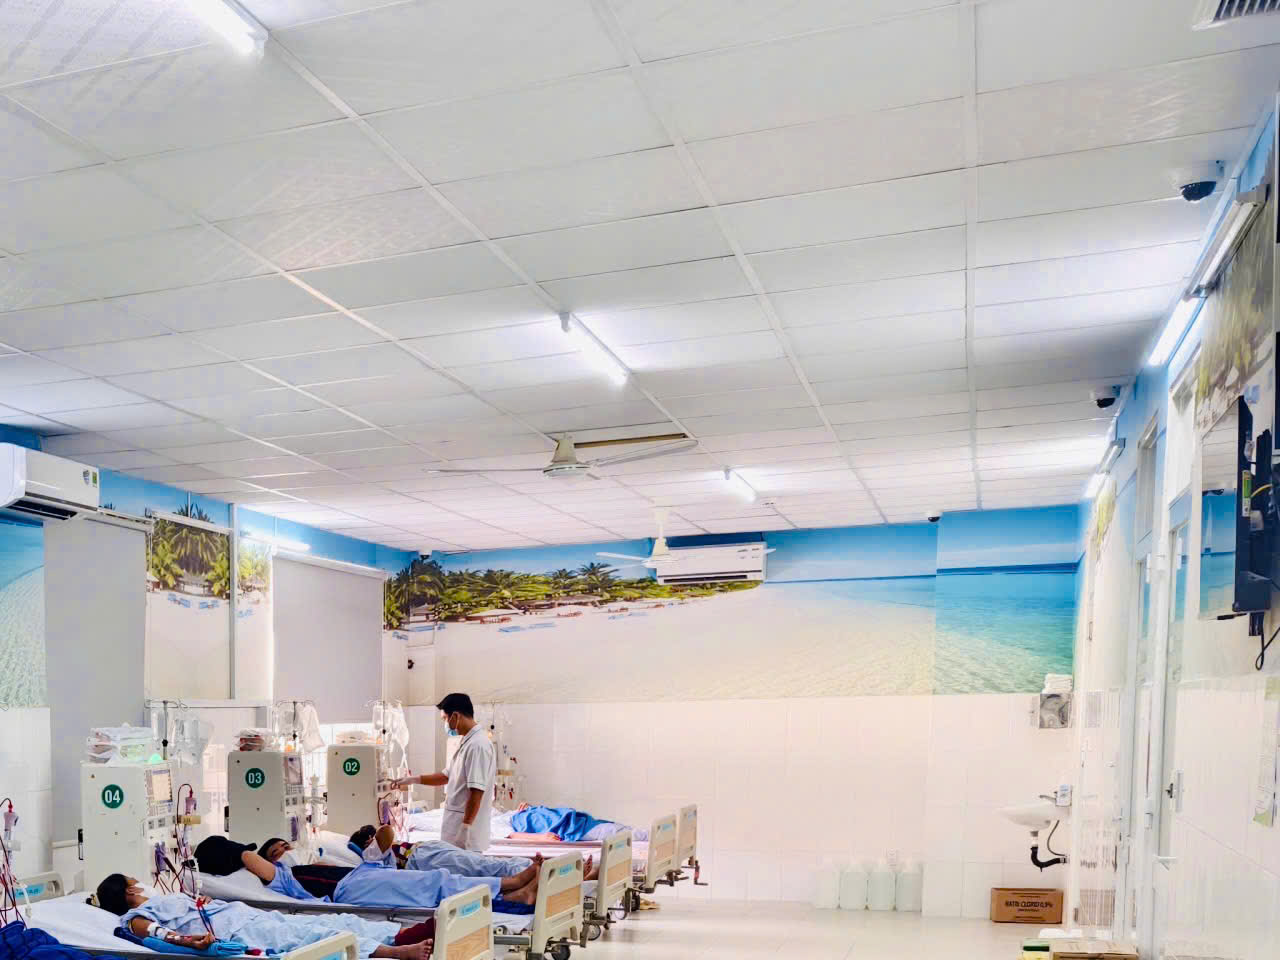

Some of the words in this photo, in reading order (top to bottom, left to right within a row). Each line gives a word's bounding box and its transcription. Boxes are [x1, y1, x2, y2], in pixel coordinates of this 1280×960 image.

[345, 761, 358, 772] 02
[248, 772, 262, 784] 03
[104, 789, 121, 803] 04
